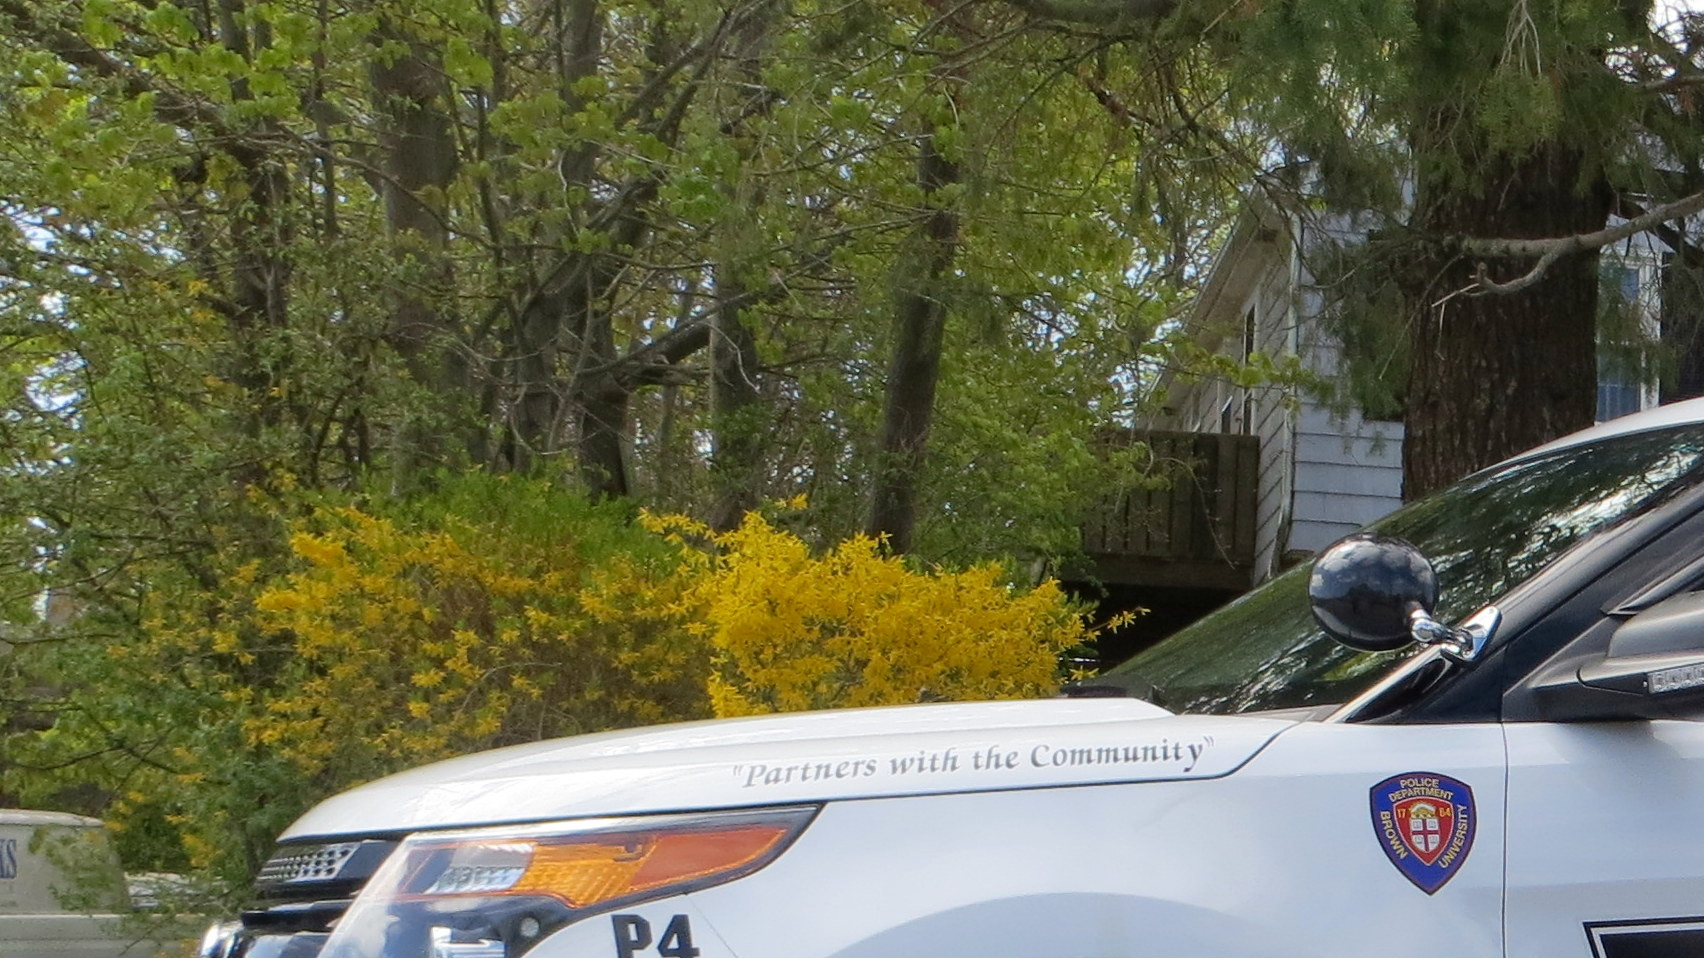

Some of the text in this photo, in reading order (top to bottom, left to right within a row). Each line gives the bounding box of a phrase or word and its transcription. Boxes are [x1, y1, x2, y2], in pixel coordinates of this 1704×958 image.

[733, 736, 1214, 788] "Partners with the Community"
[1400, 777, 1440, 788] POLICE
[1388, 787, 1454, 802] DEPARTMENT
[1380, 810, 1408, 859] BROWN
[1438, 804, 1468, 869] UNIVERSITY
